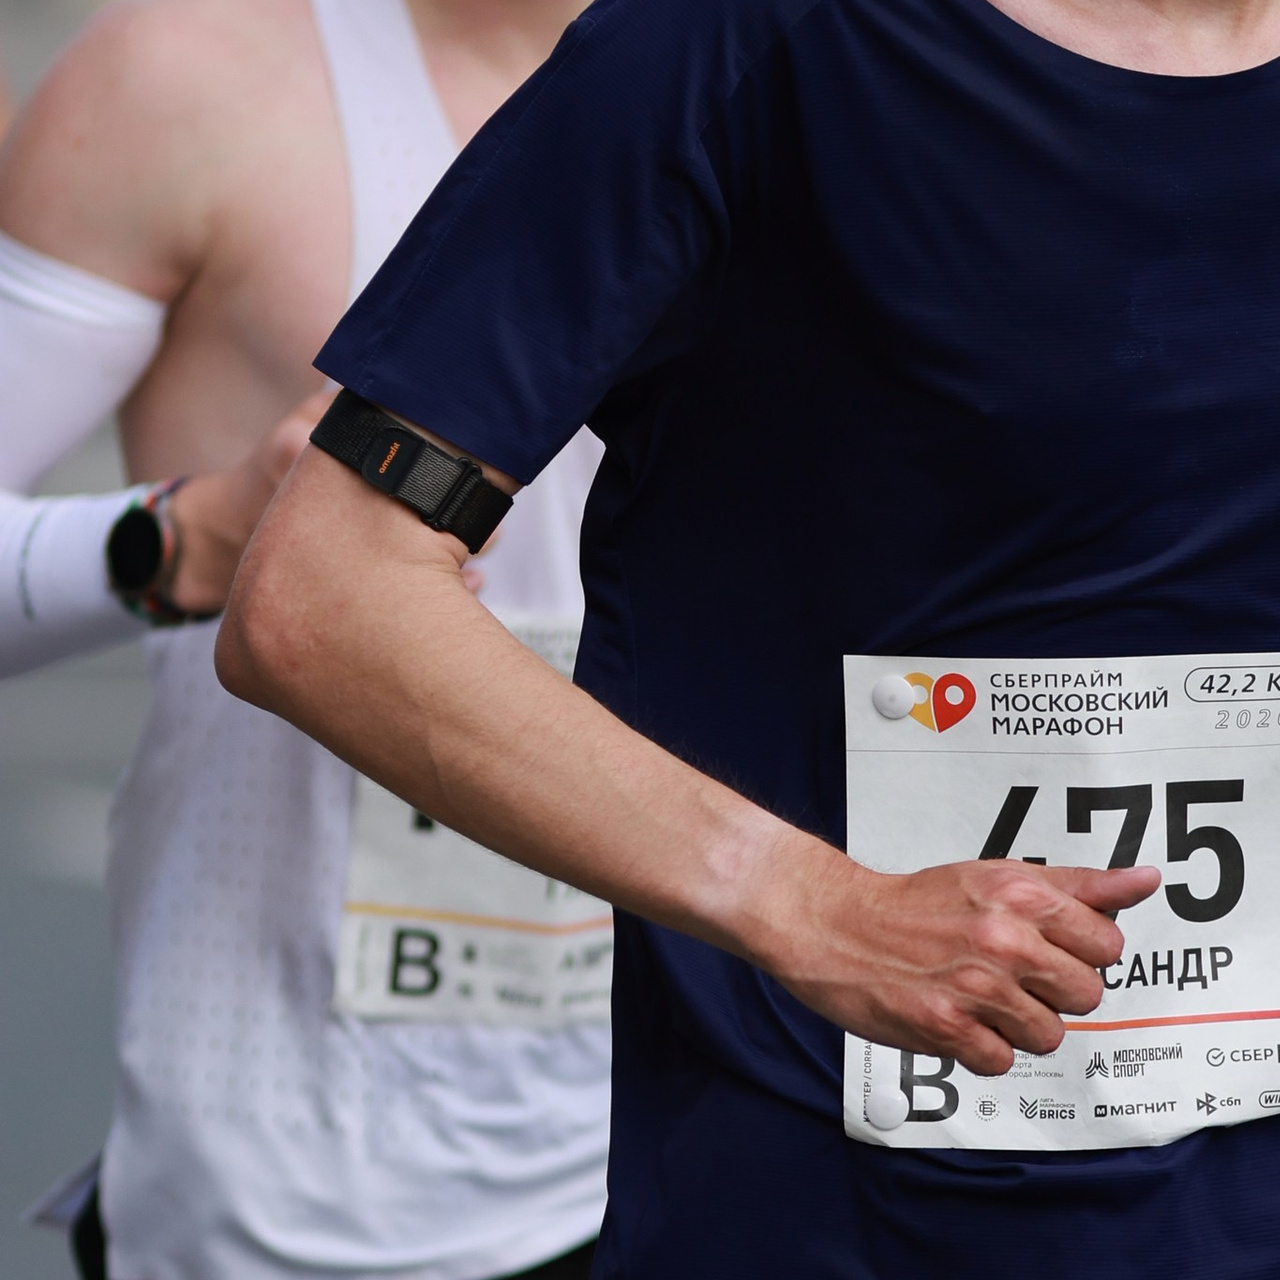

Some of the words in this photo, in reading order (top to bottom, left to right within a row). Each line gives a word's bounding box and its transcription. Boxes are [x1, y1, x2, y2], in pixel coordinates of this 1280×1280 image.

[990, 670, 1122, 688] СБЕРПРАЙМ
[1200, 673, 1256, 696] 42,2
[991, 686, 1168, 712] МОСКОВСКИЙ
[992, 717, 1123, 736] МАРАФОН
[1100, 946, 1233, 991] САНДР
[1113, 1043, 1183, 1063] МОСКОВСКИЙ
[1230, 1048, 1274, 1062] СБЕР
[1113, 1063, 1145, 1078] СПОРТ
[1039, 1109, 1076, 1119] BRICS
[1110, 1101, 1177, 1116] магнит
